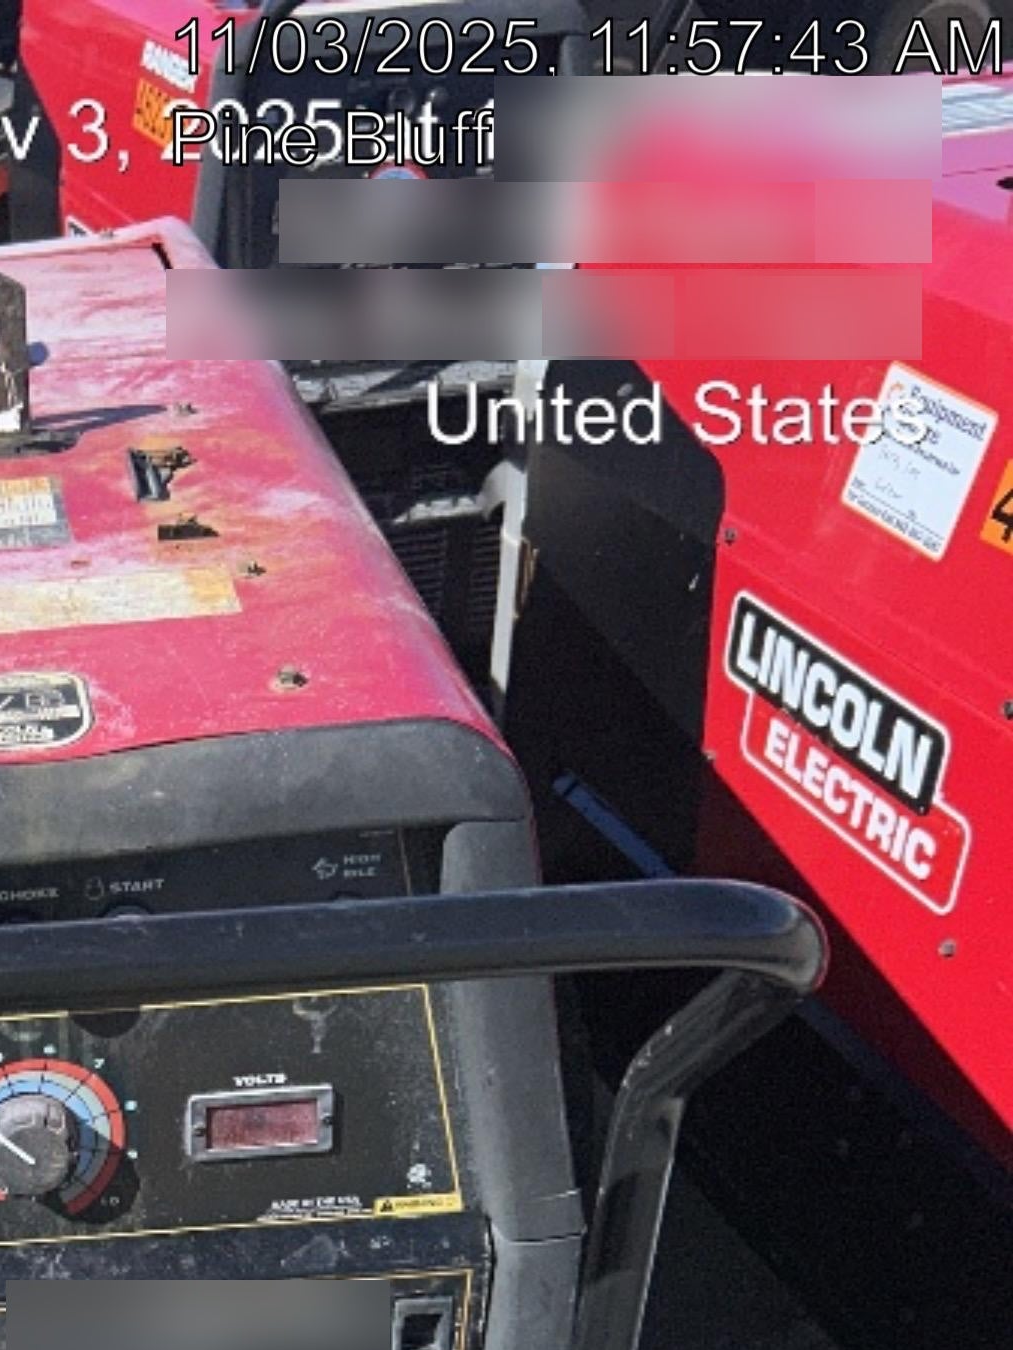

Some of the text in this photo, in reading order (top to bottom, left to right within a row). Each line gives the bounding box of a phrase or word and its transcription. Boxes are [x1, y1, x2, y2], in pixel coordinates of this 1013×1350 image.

[736, 611, 934, 801] LINCOLN
[763, 718, 938, 881] ELECTRIC
[109, 877, 166, 894] START
[233, 1072, 287, 1087] VOLTS
